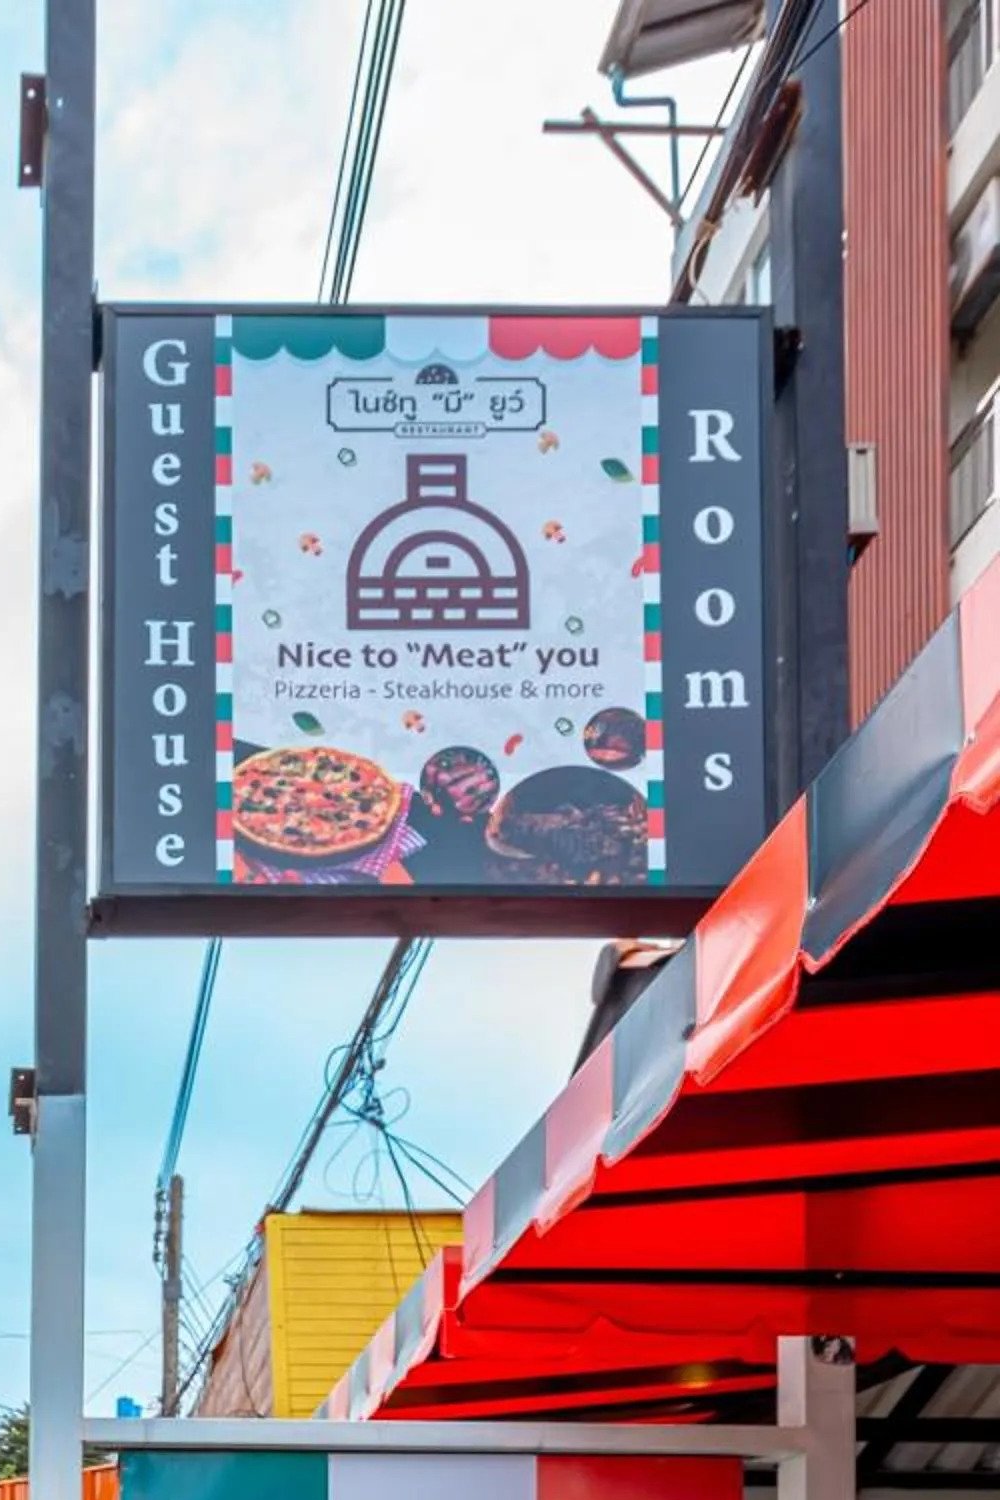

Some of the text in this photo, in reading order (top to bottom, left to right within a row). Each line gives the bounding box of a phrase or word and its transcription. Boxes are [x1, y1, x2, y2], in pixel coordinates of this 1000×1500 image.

[401, 426, 479, 434] RESTAURANT
[142, 338, 195, 866] Guest House
[684, 408, 749, 792] Rooms
[277, 641, 599, 674] Nice to “Meat” you
[274, 679, 361, 700] Pizzeria
[383, 679, 512, 700] Steakhouse
[520, 680, 538, 699] &
[546, 682, 605, 699] more
